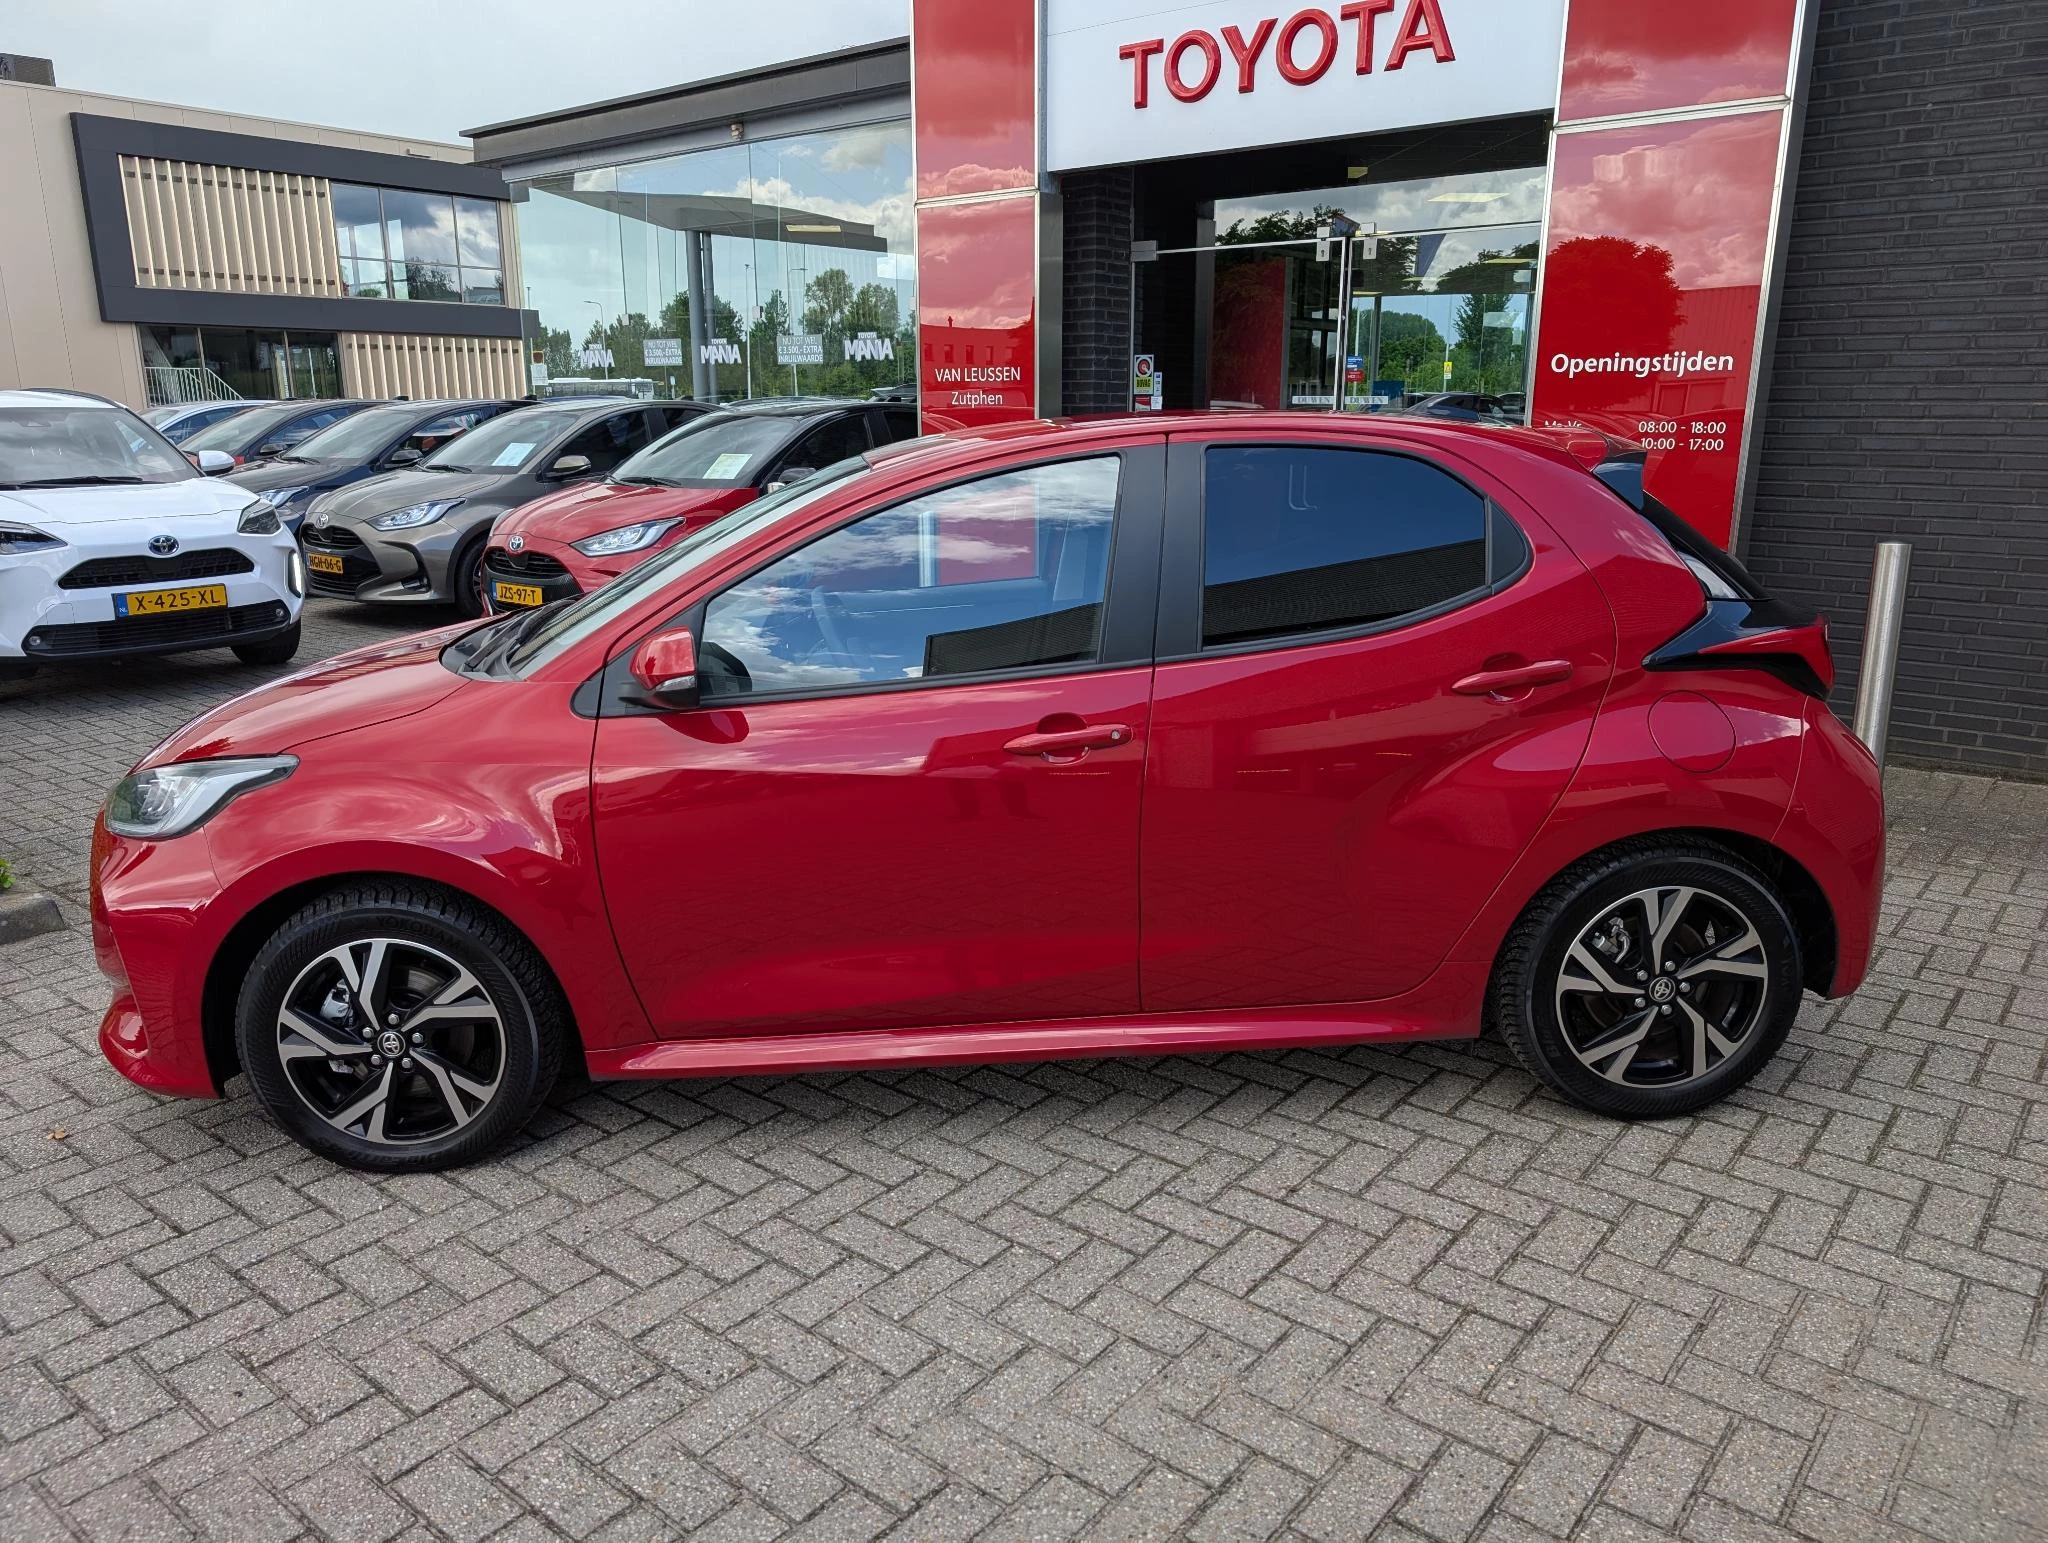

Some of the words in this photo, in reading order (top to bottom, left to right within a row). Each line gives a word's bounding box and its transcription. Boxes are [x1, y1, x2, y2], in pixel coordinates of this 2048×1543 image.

[1119, 0, 1456, 109] TOYOTA
[580, 348, 615, 368] MANIA
[700, 344, 741, 364] MANIA
[803, 345, 823, 353] EXTRA
[844, 338, 894, 361] MANIA
[1551, 350, 1733, 378] Openingstijden
[935, 368, 960, 382] VAN
[964, 366, 1020, 382] LEUSSEN
[951, 391, 1003, 408] Zutphen
[1638, 421, 1677, 433] 08:00
[1690, 421, 1727, 434] 18:00
[1640, 438, 1676, 450] 10:00
[1689, 439, 1724, 451] 17:00
[135, 589, 221, 611] X-425-XL
[500, 585, 536, 603] JZS-97-T
